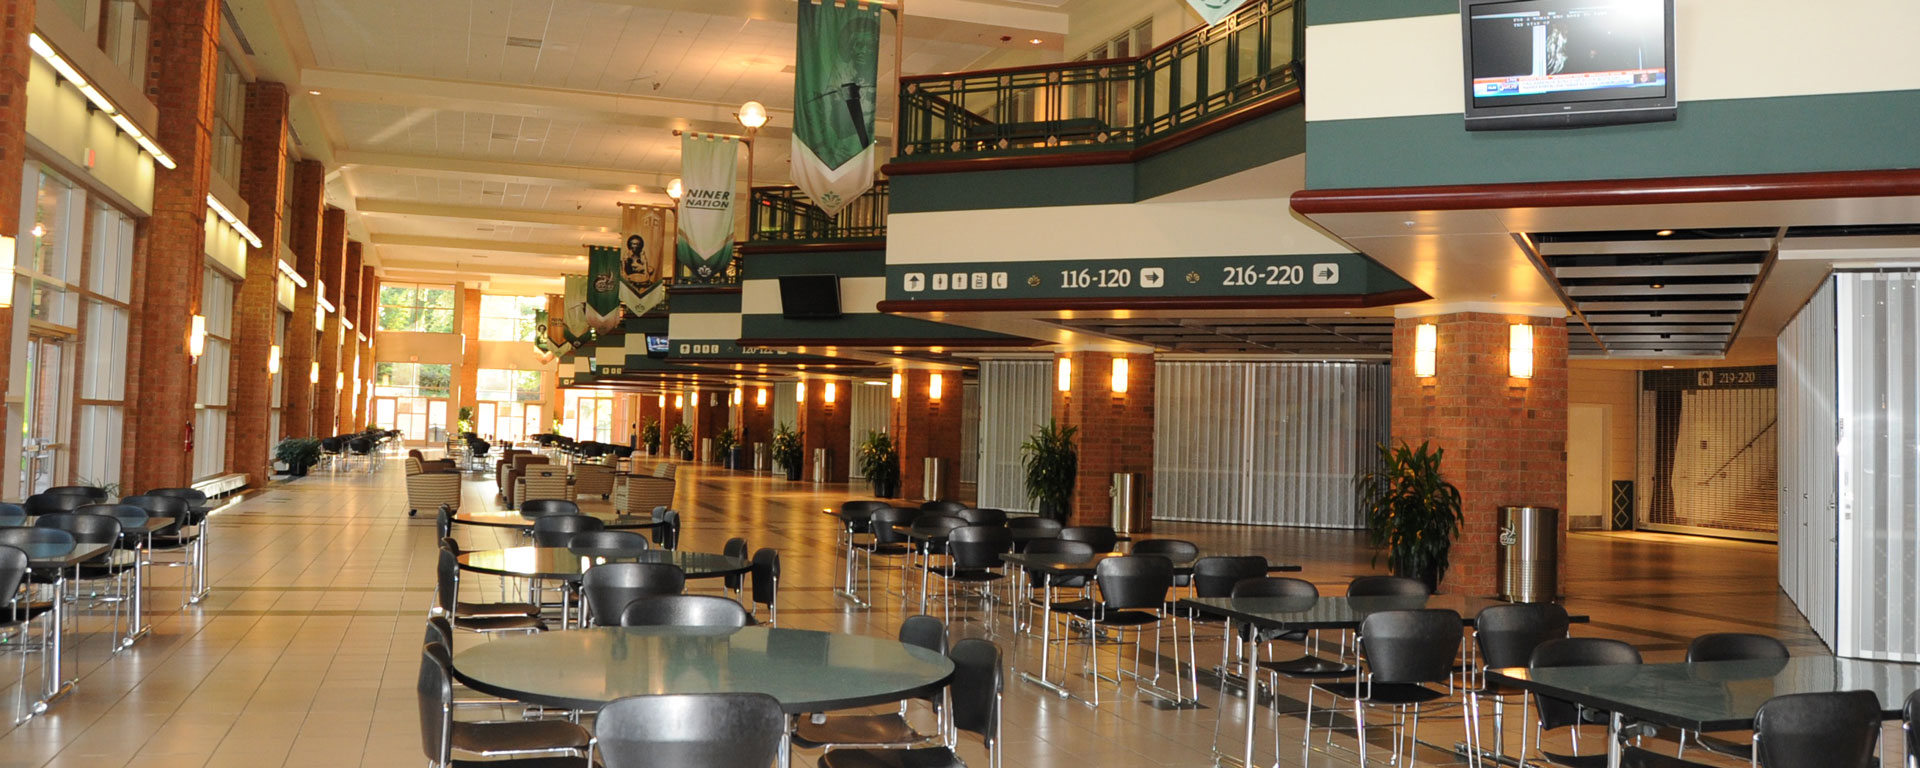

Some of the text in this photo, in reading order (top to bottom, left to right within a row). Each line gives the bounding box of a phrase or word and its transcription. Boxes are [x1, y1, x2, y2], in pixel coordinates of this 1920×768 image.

[686, 189, 730, 200] NINER
[685, 199, 729, 208] NATION
[1060, 269, 1131, 288] 116-120
[1223, 265, 1304, 285] 216-220
[1719, 372, 1755, 384] 219-220
